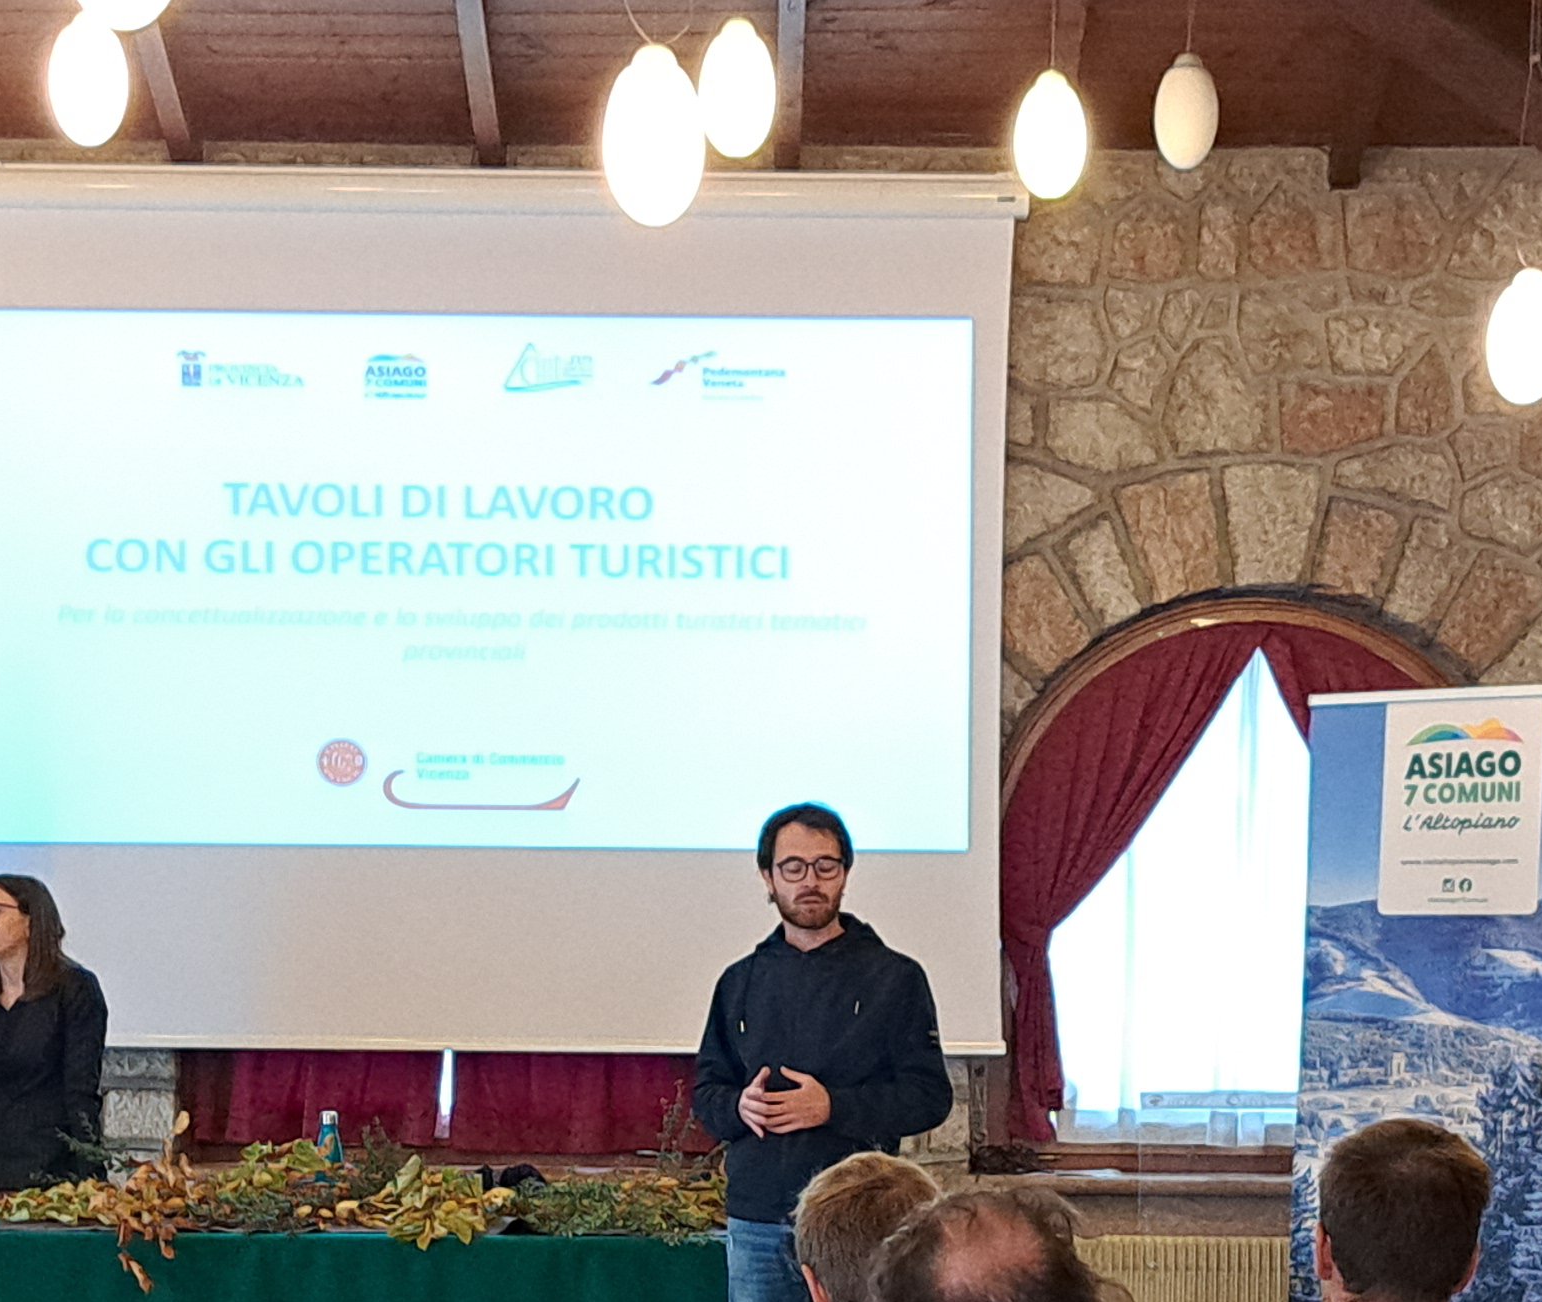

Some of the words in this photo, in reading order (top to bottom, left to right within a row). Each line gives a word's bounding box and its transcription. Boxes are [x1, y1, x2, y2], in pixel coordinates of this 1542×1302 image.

[227, 375, 305, 386] VICENZA
[365, 366, 426, 377] ASIAGO
[224, 482, 383, 517] TAVOLI
[402, 484, 445, 518] DI
[465, 485, 653, 521] LAVORO
[86, 538, 186, 573] CON
[204, 539, 274, 574] GLI
[292, 541, 554, 576] OPERATORI
[570, 544, 789, 580] TURISTICI
[58, 604, 94, 624] Per
[373, 611, 388, 626] e
[425, 608, 522, 631] sviluppo
[571, 610, 668, 633] prodotti
[676, 612, 764, 631] turistici
[770, 612, 867, 631] tematici
[402, 643, 527, 665] provinciali
[416, 752, 467, 764] Camera
[472, 753, 485, 764] di
[489, 753, 565, 766] Commercio
[1404, 750, 1521, 779] ASIAGO
[416, 768, 470, 780] Vicenza
[1404, 784, 1419, 807] 7
[1423, 781, 1521, 804] COMUNI
[1402, 812, 1520, 836] L'Altopiano
